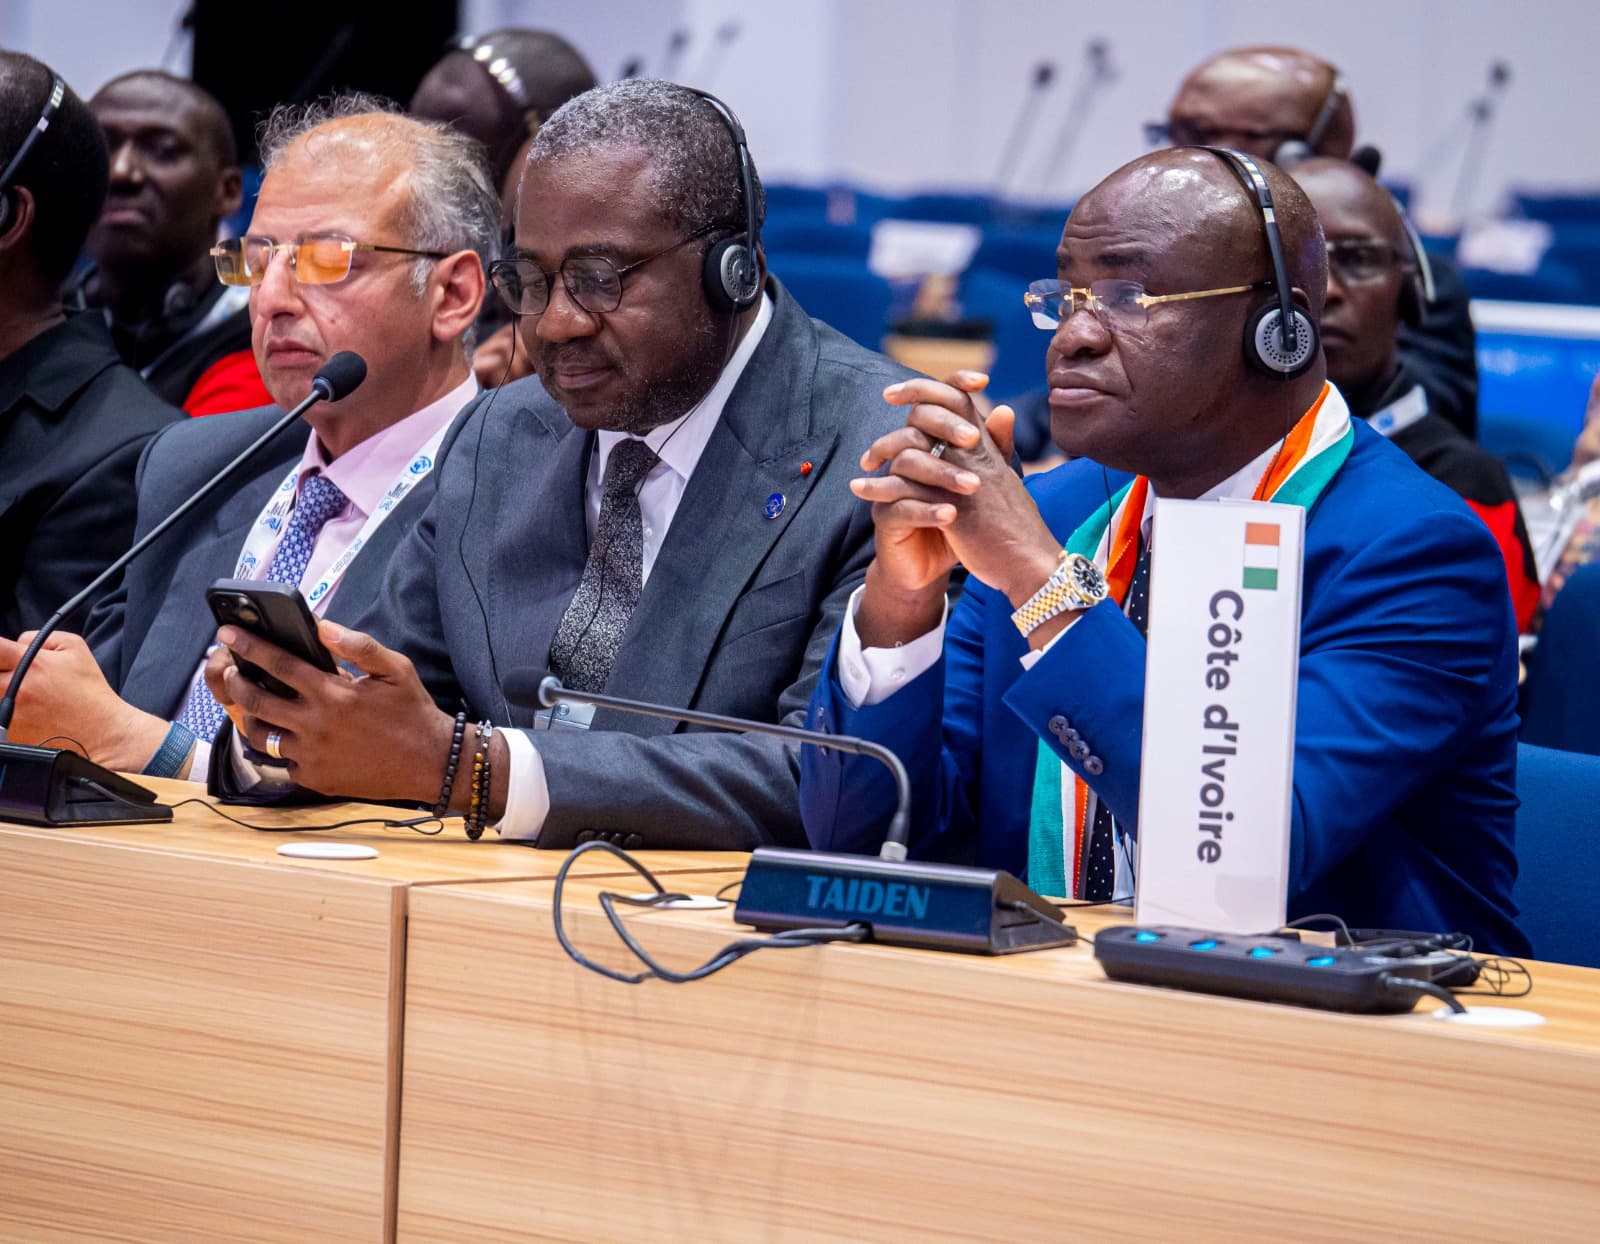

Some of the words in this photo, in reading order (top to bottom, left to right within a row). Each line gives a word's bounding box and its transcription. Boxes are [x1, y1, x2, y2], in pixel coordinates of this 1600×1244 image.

[1205, 589, 1244, 690] Côte
[1196, 704, 1239, 863] d'Ivoire
[806, 876, 930, 918] TAIDEN
